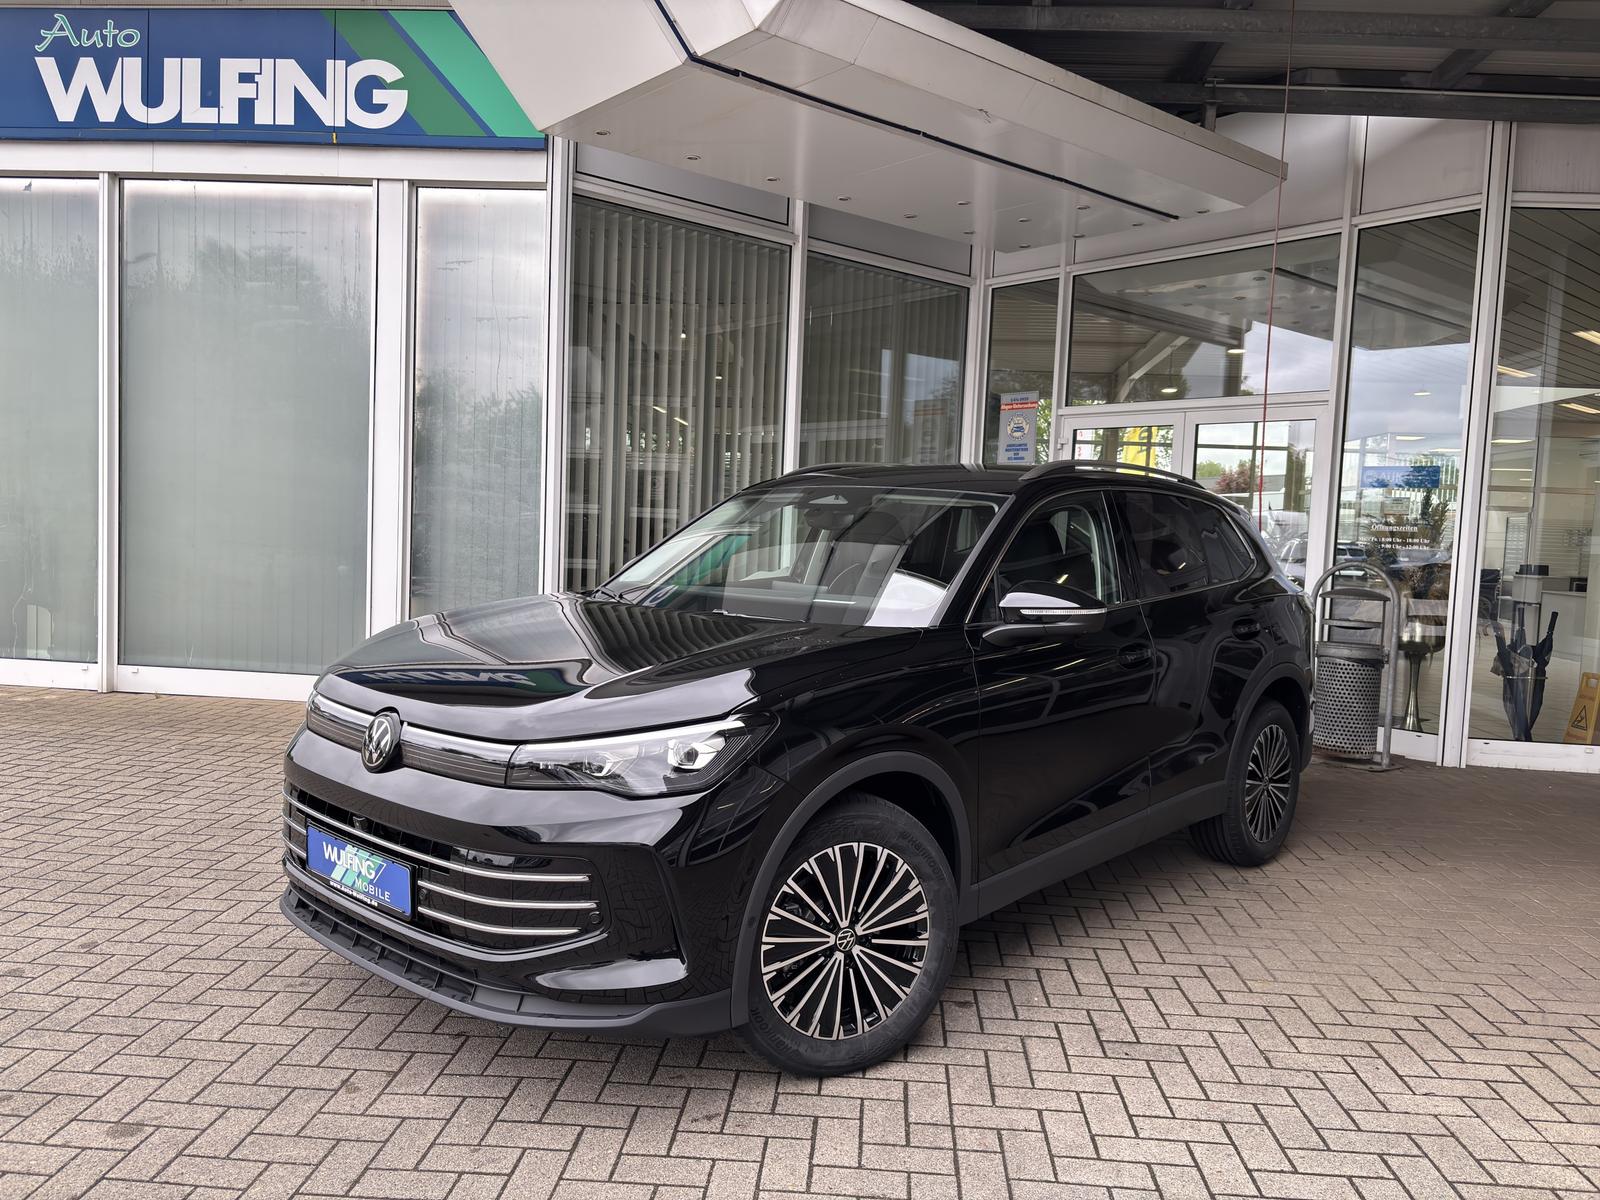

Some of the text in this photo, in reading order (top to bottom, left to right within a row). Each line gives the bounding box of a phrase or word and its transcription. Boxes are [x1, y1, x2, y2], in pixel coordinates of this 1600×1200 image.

[35, 13, 141, 53] Auto
[34, 57, 409, 129] WULFING
[323, 841, 376, 879] WULFING
[354, 876, 391, 902] MOBILE
